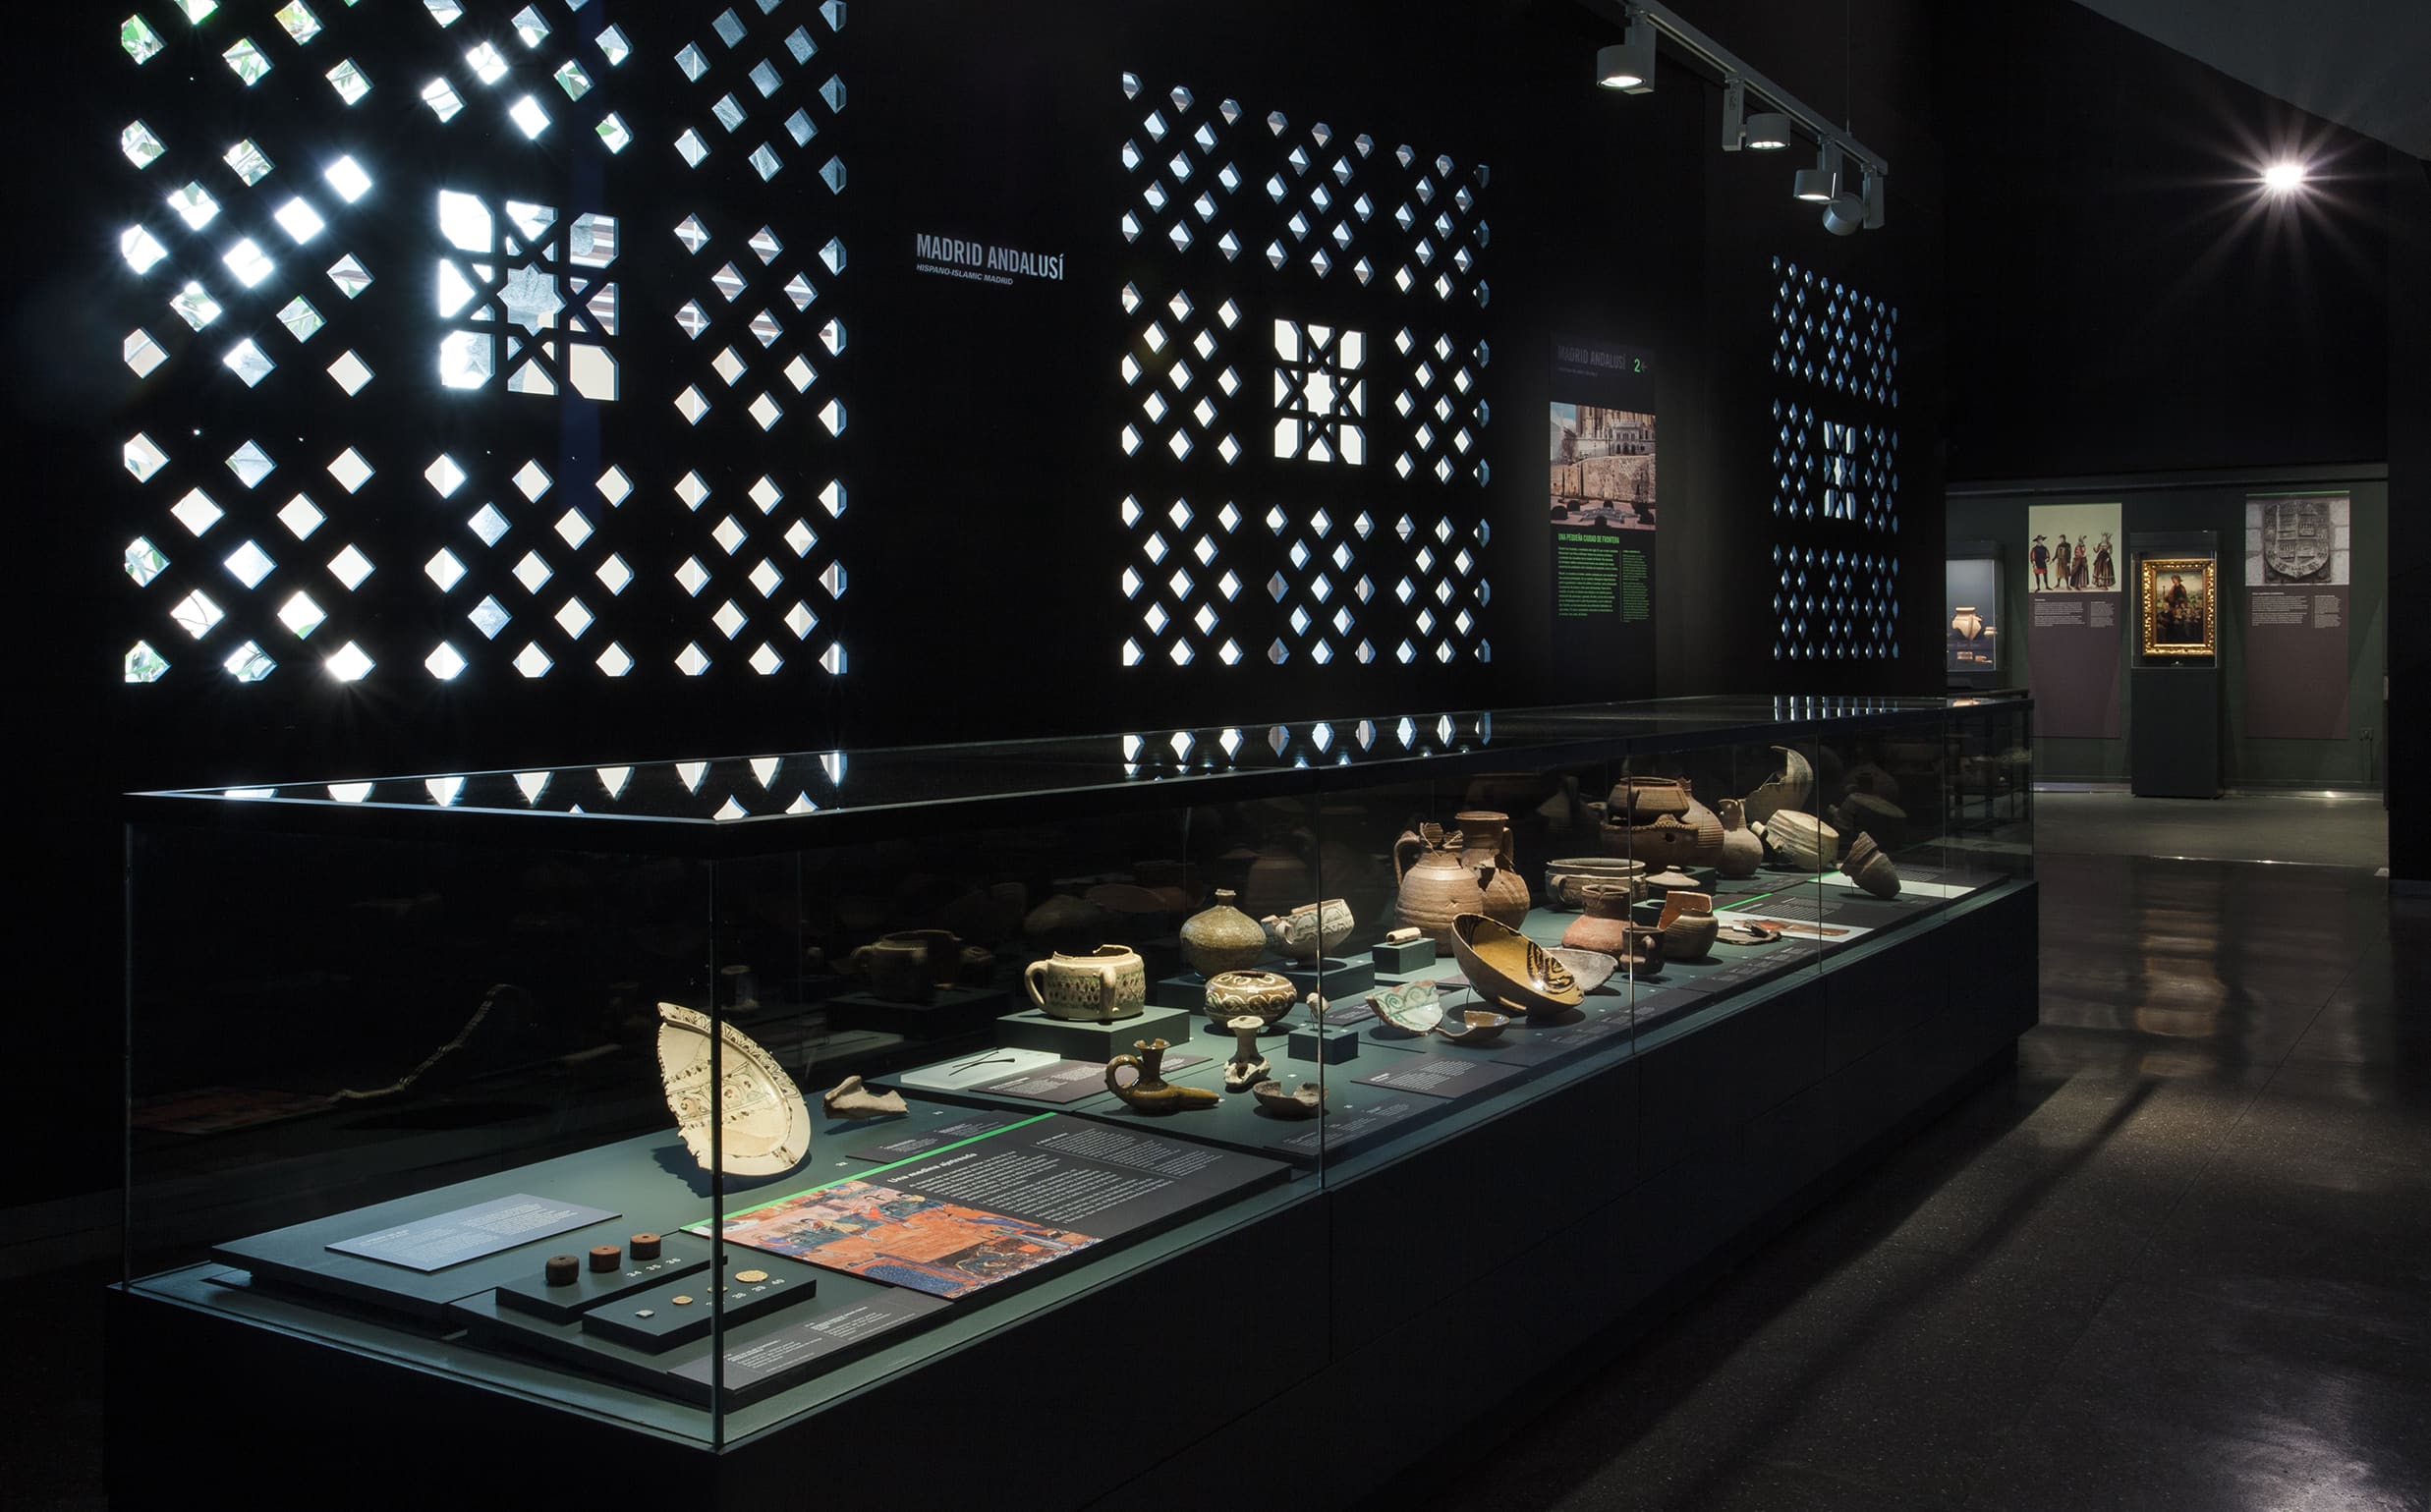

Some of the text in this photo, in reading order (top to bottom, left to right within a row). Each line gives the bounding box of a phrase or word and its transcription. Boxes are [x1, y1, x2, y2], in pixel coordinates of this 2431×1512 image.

[917, 233, 1064, 281] MADRID ANDALUSÍ
[916, 263, 1014, 286] HISPANO-ISLAMIC MADRID
[1557, 346, 1589, 364] MADRID
[1634, 358, 1641, 372] 2
